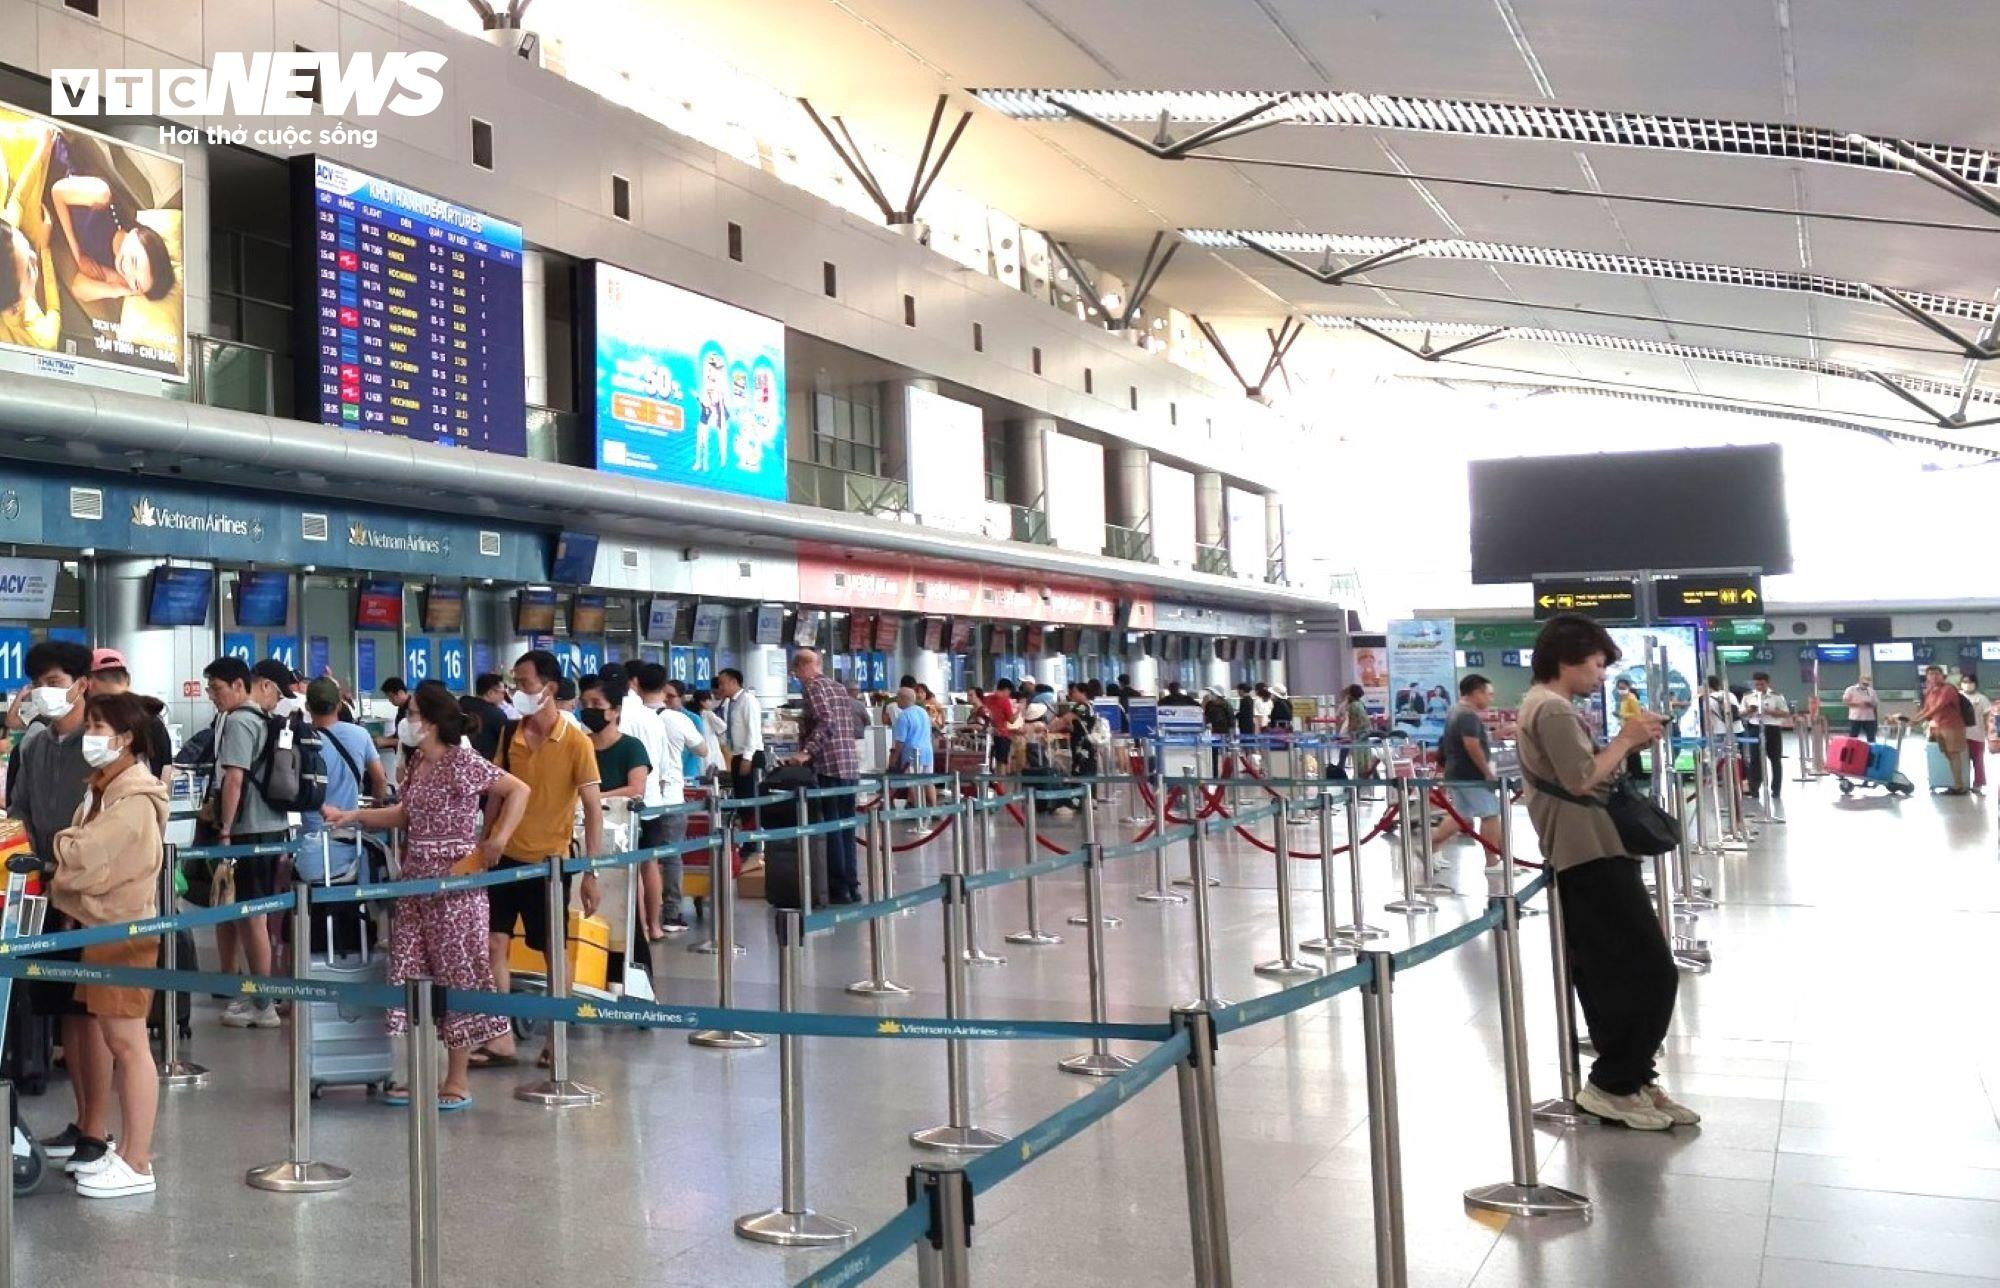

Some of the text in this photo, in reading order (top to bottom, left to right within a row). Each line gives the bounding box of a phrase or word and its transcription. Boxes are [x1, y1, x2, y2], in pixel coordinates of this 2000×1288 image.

[155, 508, 248, 535] Vietnam Airlines
[366, 531, 440, 554] Vietnam Airlines
[0, 574, 27, 594] ACV
[0, 641, 22, 679] 11
[1468, 655, 1482, 665] 41
[1503, 655, 1518, 665] 42
[1756, 650, 1773, 660] 45
[1800, 650, 1817, 660] 46
[1916, 647, 1933, 657] 47
[409, 649, 427, 678] 15
[444, 650, 461, 678] 16
[583, 654, 598, 675] 18
[674, 657, 687, 681] 19
[697, 657, 710, 681] 20
[873, 660, 885, 681] 24
[41, 968, 102, 979] Vietnam Airlines
[258, 984, 327, 997] Vietnam Airlines
[598, 1008, 682, 1023] Vietnam Airlines
[901, 1024, 998, 1036] Vietnam Airlines
